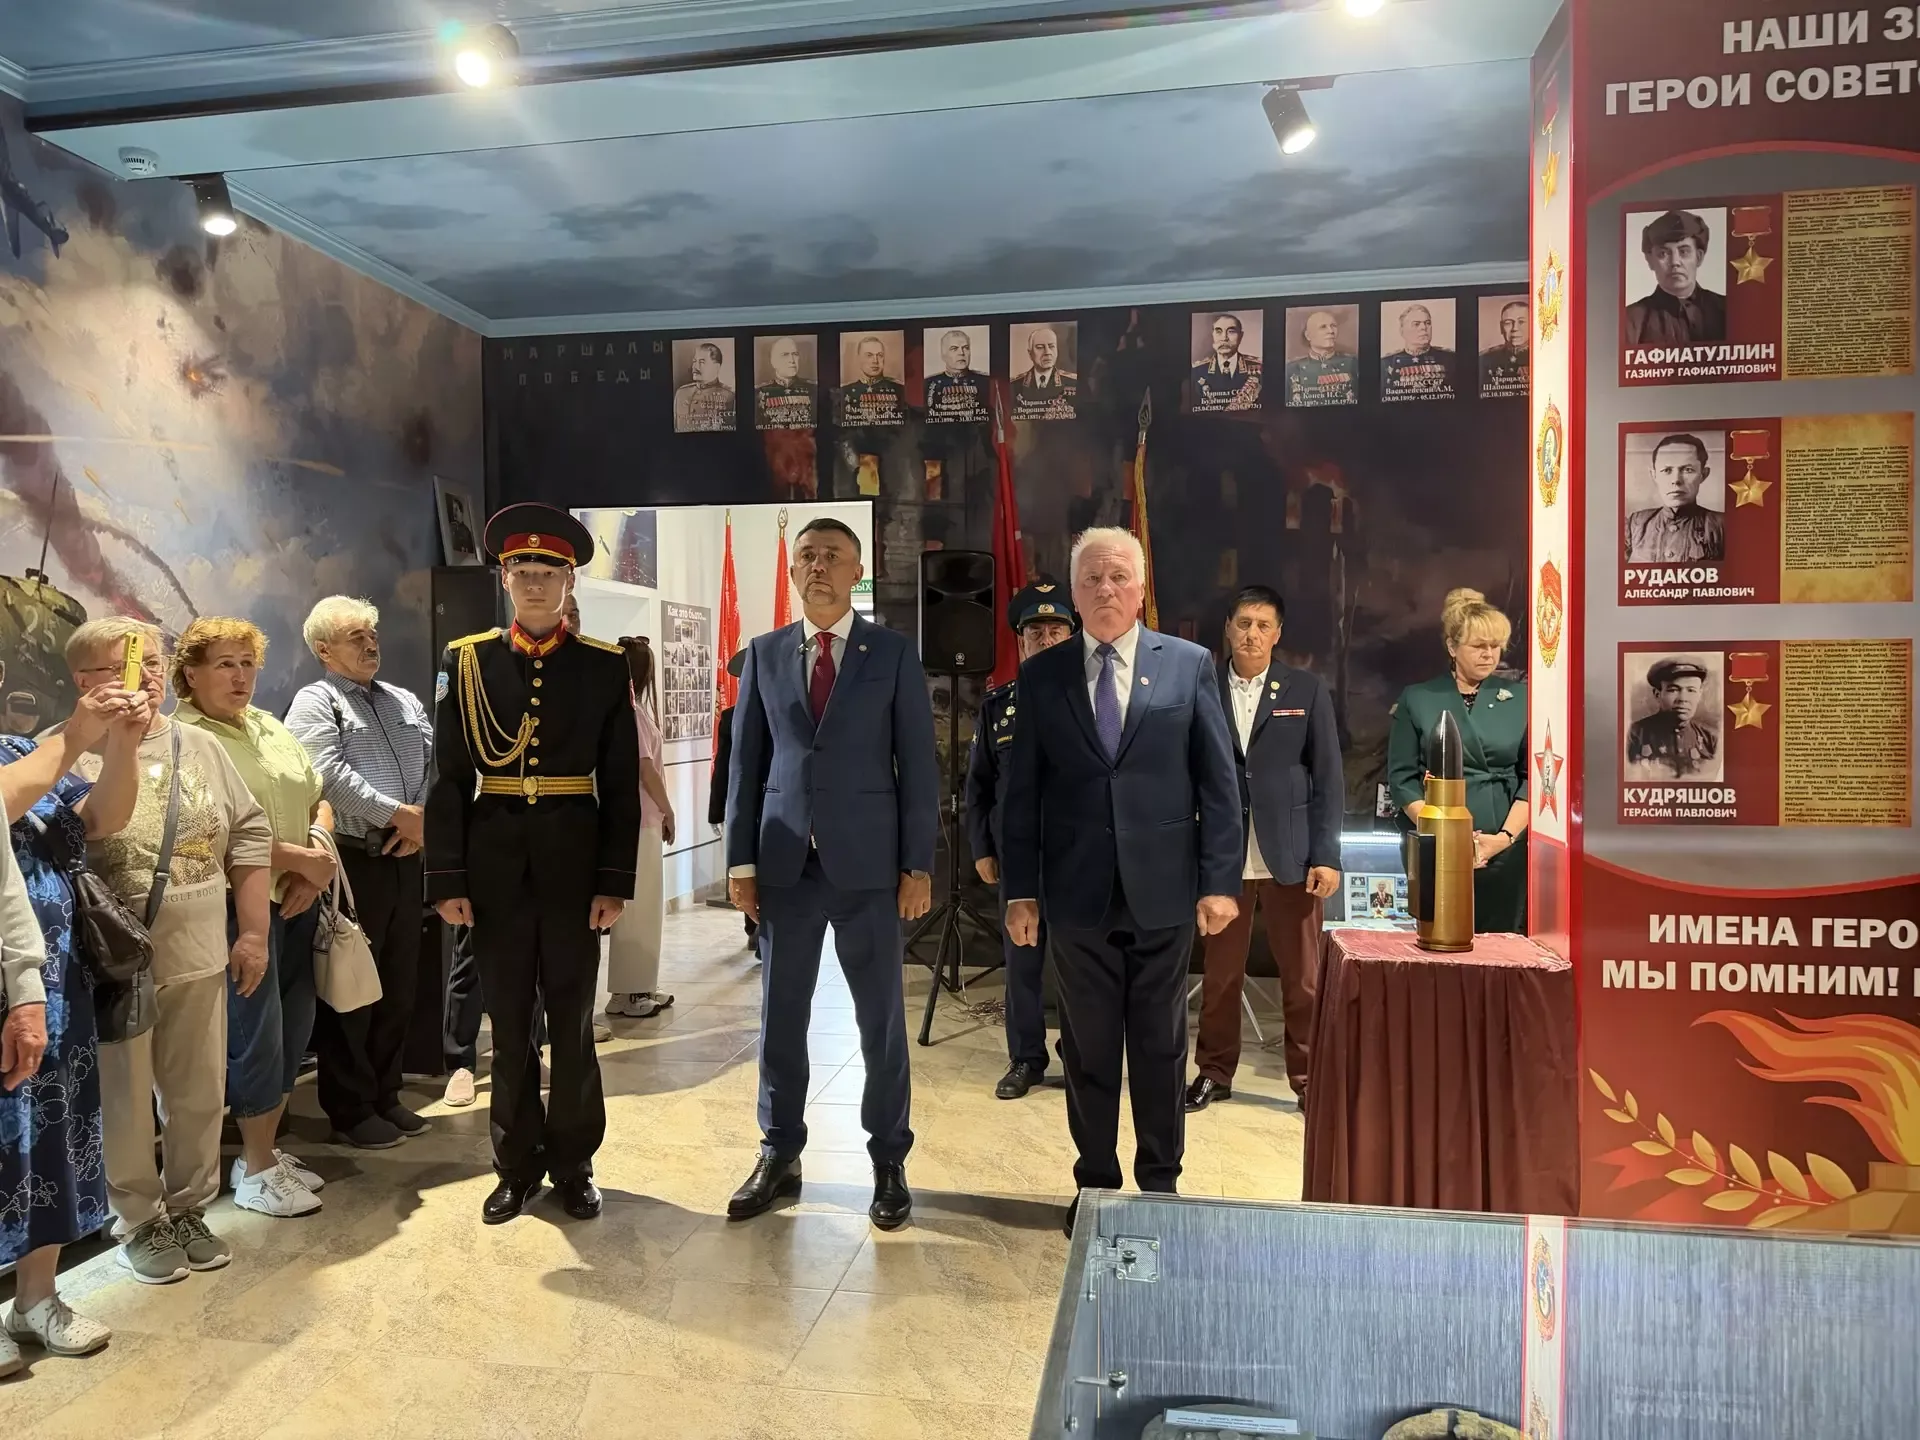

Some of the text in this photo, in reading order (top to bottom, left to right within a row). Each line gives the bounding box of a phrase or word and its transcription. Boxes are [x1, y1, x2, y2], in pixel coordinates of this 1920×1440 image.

[1722, 6, 1920, 54] НАШИ З
[1606, 60, 1920, 115] ГЕРОИ СОВЕТ
[503, 341, 664, 360] МАРШАЛЫ
[1625, 343, 1775, 366] ГАФИАТУЛЛИН
[519, 368, 651, 386] ПОБЕДЫ
[1625, 363, 1776, 379] ГАЗИНУР ГАФИАТУЛЛОВИЧ
[1624, 568, 1719, 586] РУДАКОВ
[1625, 587, 1755, 599] АЛЕКСАНДР ПАВЛОВИЧ
[667, 604, 678, 617] Как
[1624, 788, 1737, 806] КУДРЯШОВ
[1624, 808, 1737, 819] ГЕРАСИМ ПАВЛОВИЧ
[1649, 914, 1919, 949] ИМЕНА ГЕРО
[1602, 959, 1676, 990] МЫ
[1690, 961, 1900, 996] ПОМНИМ!
